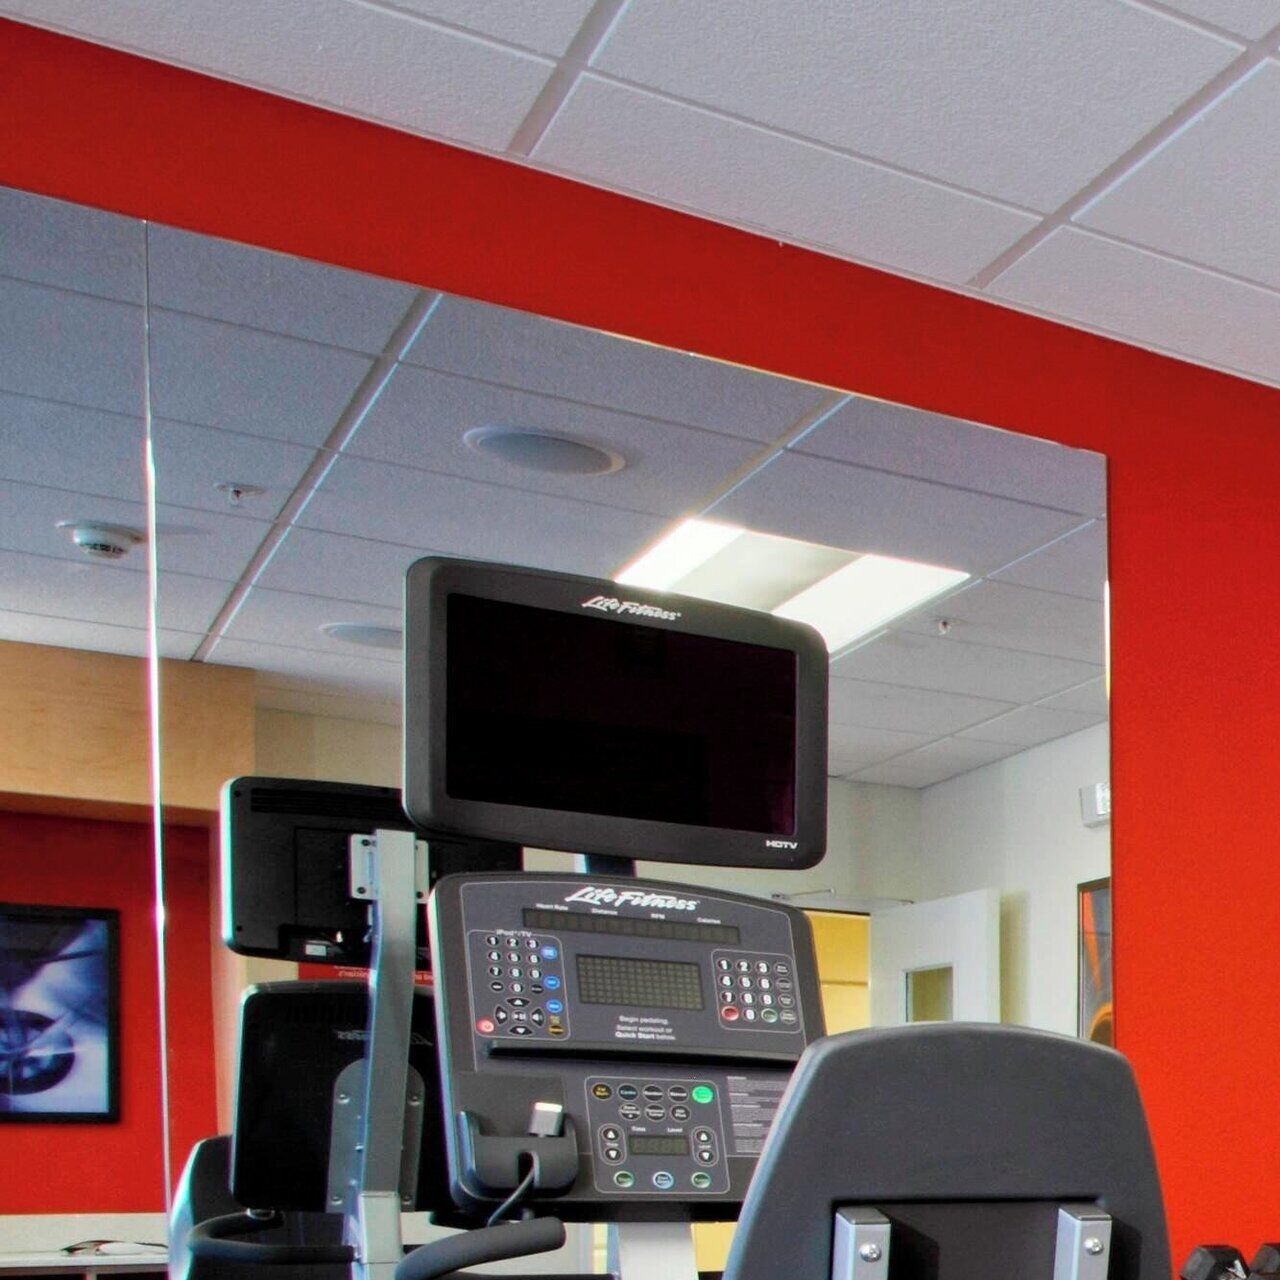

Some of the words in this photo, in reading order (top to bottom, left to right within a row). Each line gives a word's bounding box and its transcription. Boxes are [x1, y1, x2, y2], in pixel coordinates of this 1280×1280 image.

[581, 596, 620, 612] Life
[765, 840, 798, 849] HDTV
[564, 886, 618, 905] Life
[614, 891, 698, 911] Fitness
